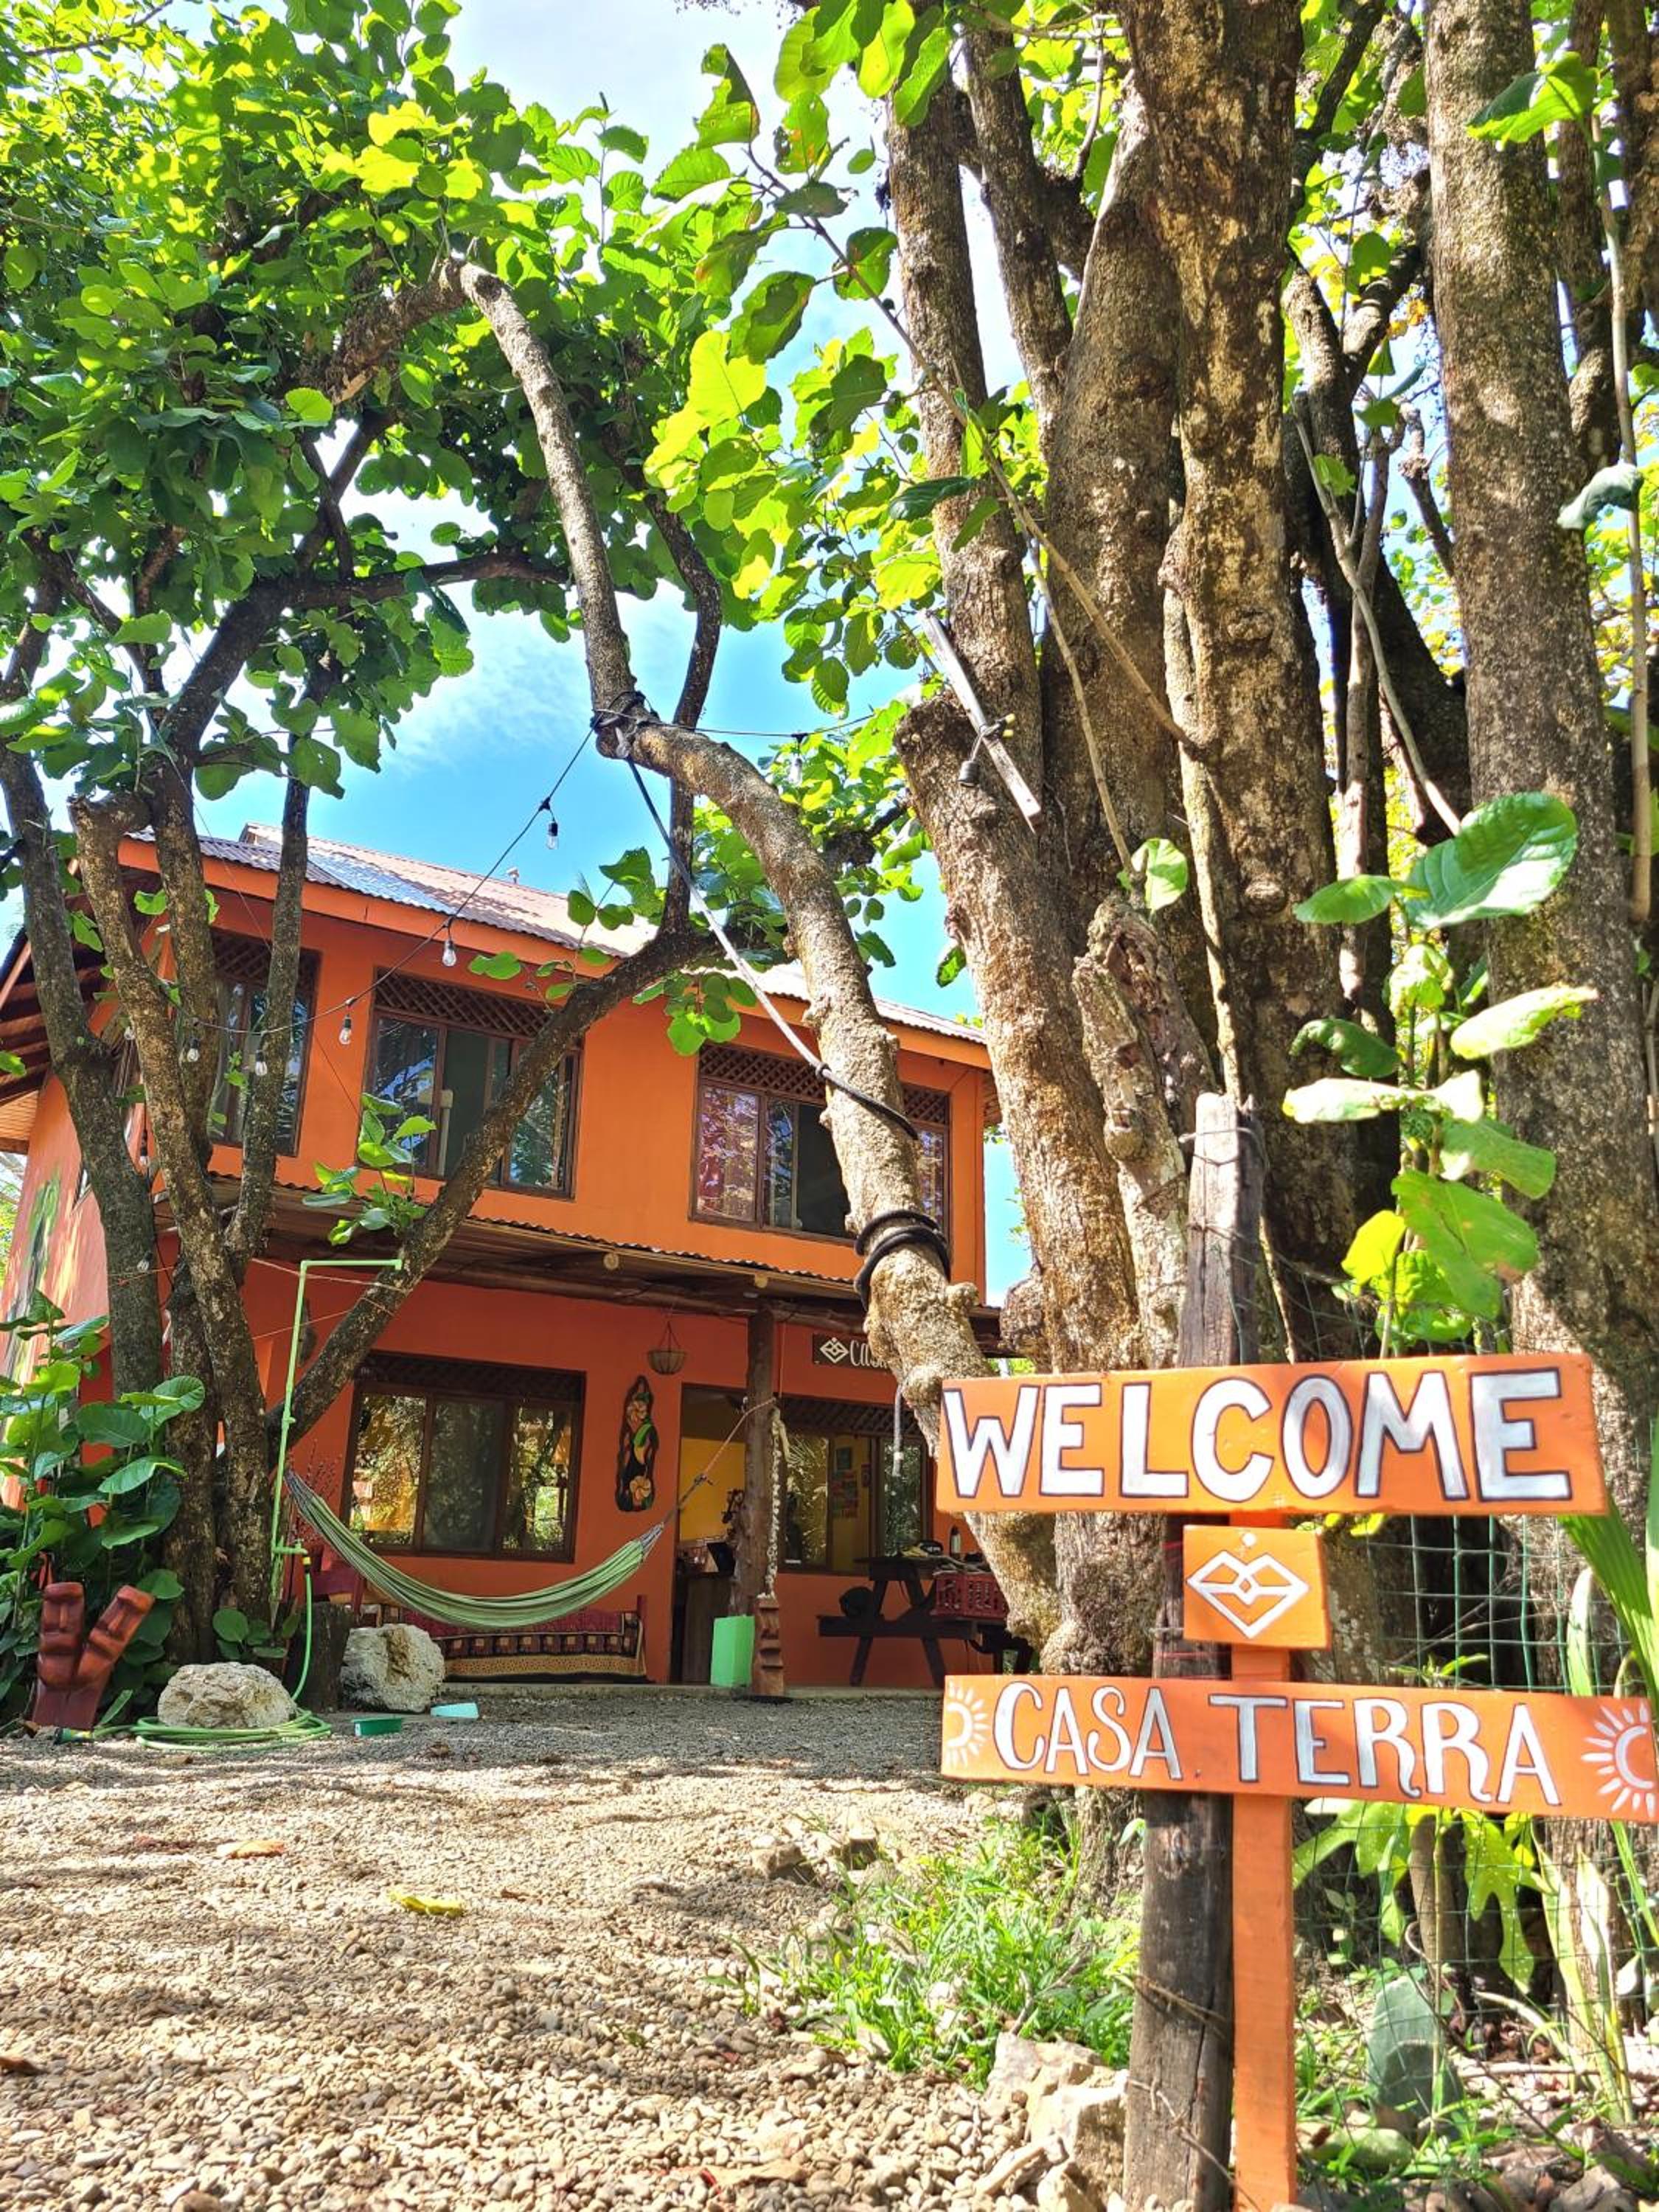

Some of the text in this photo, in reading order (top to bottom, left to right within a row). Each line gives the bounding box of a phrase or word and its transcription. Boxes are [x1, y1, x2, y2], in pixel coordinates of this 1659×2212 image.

[942, 1368, 1572, 1502] WELCOME
[992, 1681, 1562, 1806] CASA TERRA
